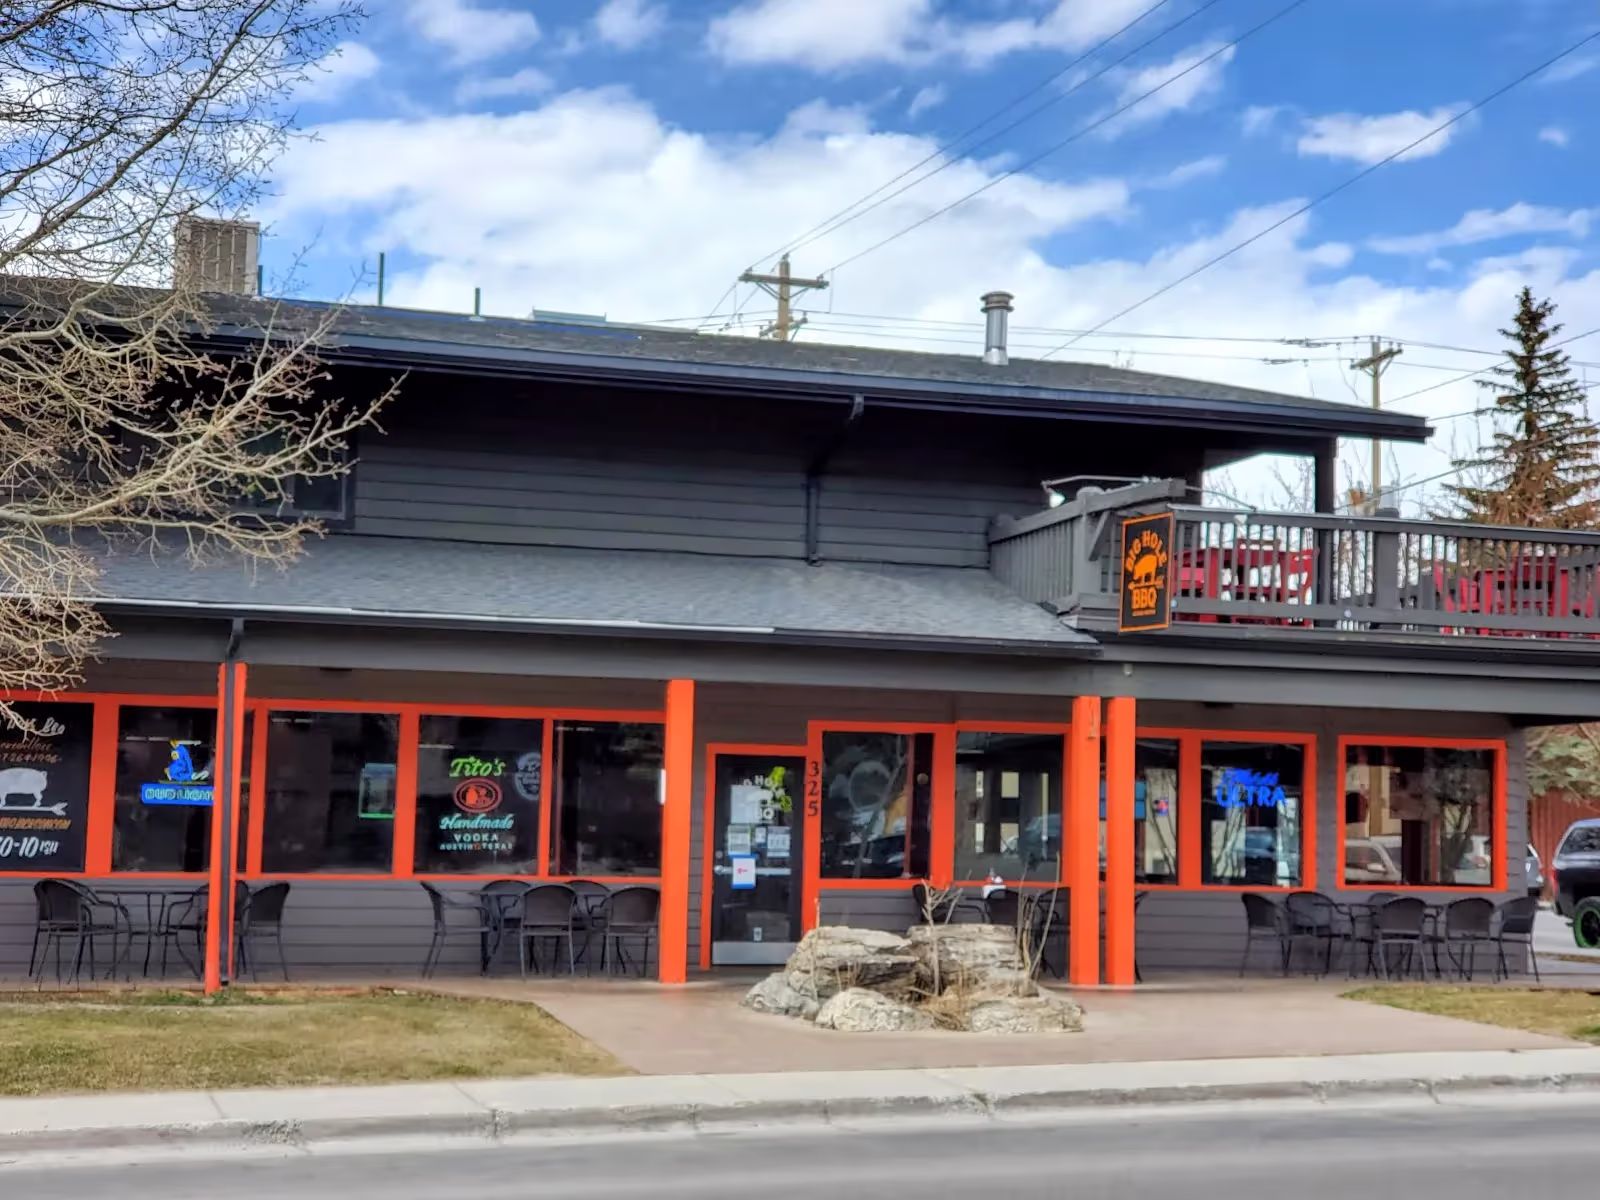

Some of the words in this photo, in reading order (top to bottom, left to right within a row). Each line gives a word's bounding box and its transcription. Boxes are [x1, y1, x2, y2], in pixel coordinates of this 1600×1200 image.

[1132, 587, 1157, 609] BBQ
[450, 756, 506, 777] Tito's
[807, 761, 820, 817] 325
[1216, 785, 1287, 807] ULTRA
[439, 813, 515, 830] Handmade
[454, 833, 500, 843] VODKA
[481, 842, 513, 851] TEXAS
